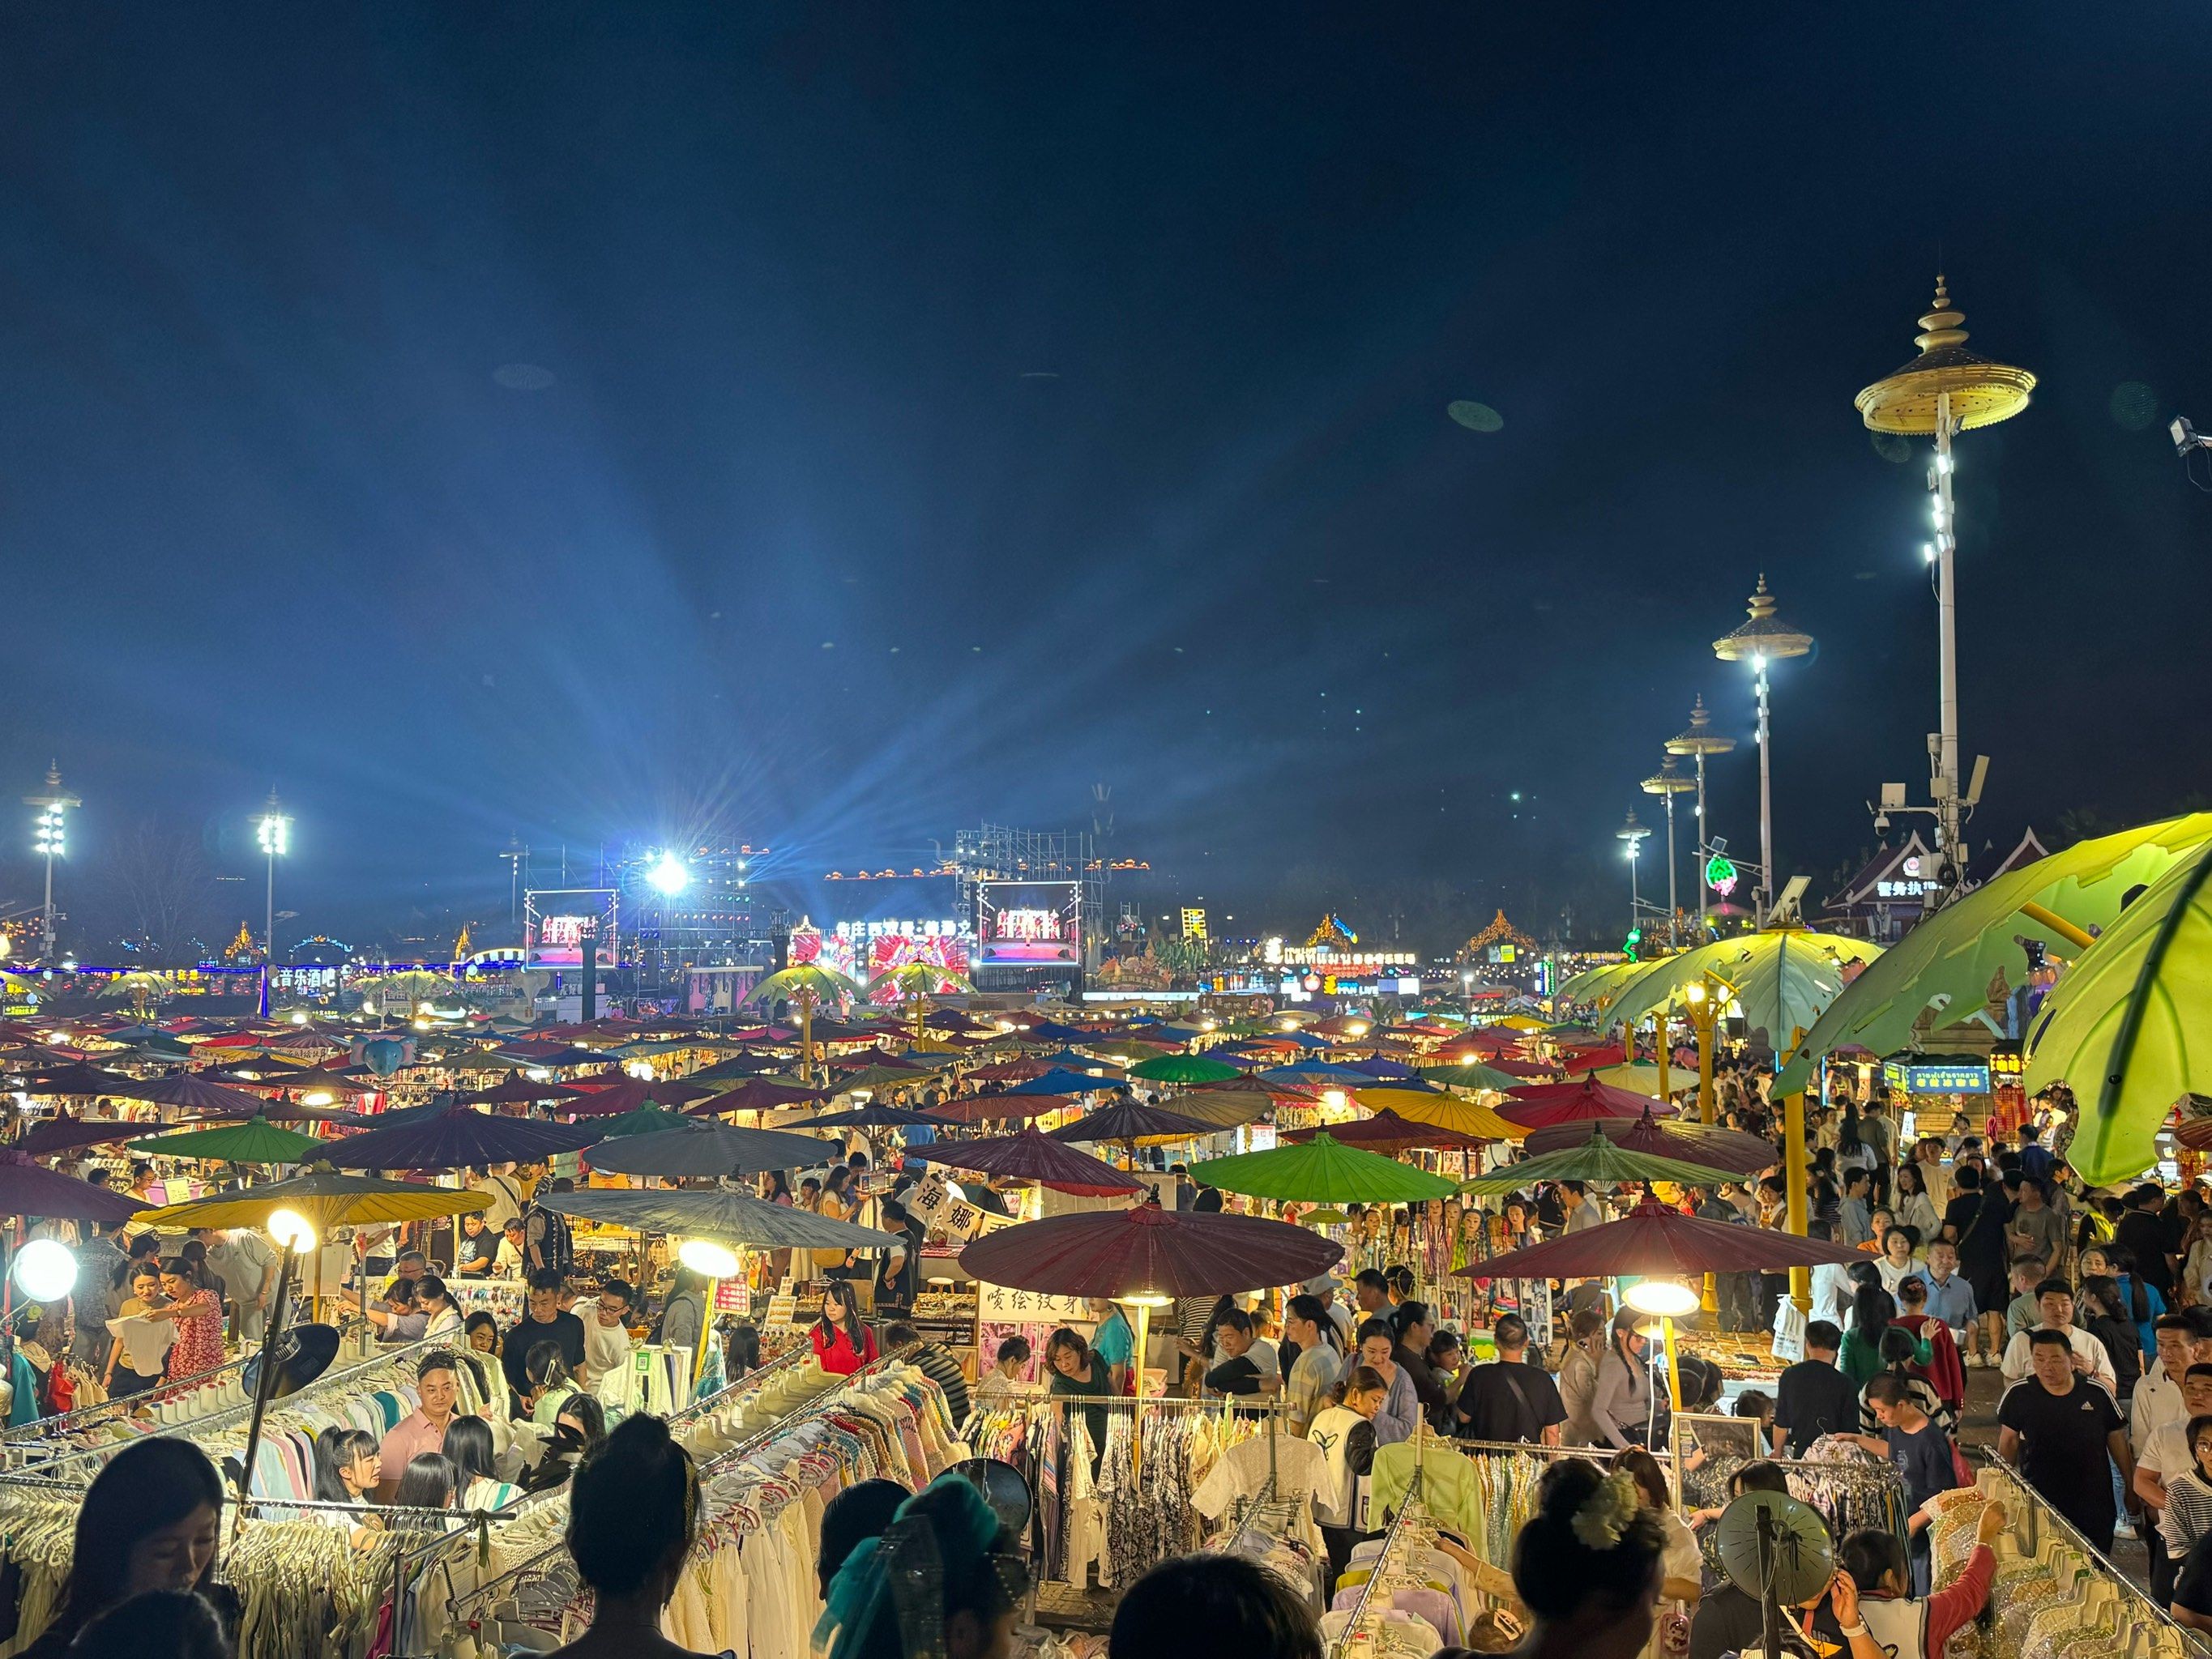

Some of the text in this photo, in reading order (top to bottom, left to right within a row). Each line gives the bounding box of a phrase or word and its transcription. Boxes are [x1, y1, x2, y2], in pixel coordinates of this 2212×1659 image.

[1877, 881, 1942, 897] 警务执
[987, 1287, 1080, 1316] 喷绘纹身
